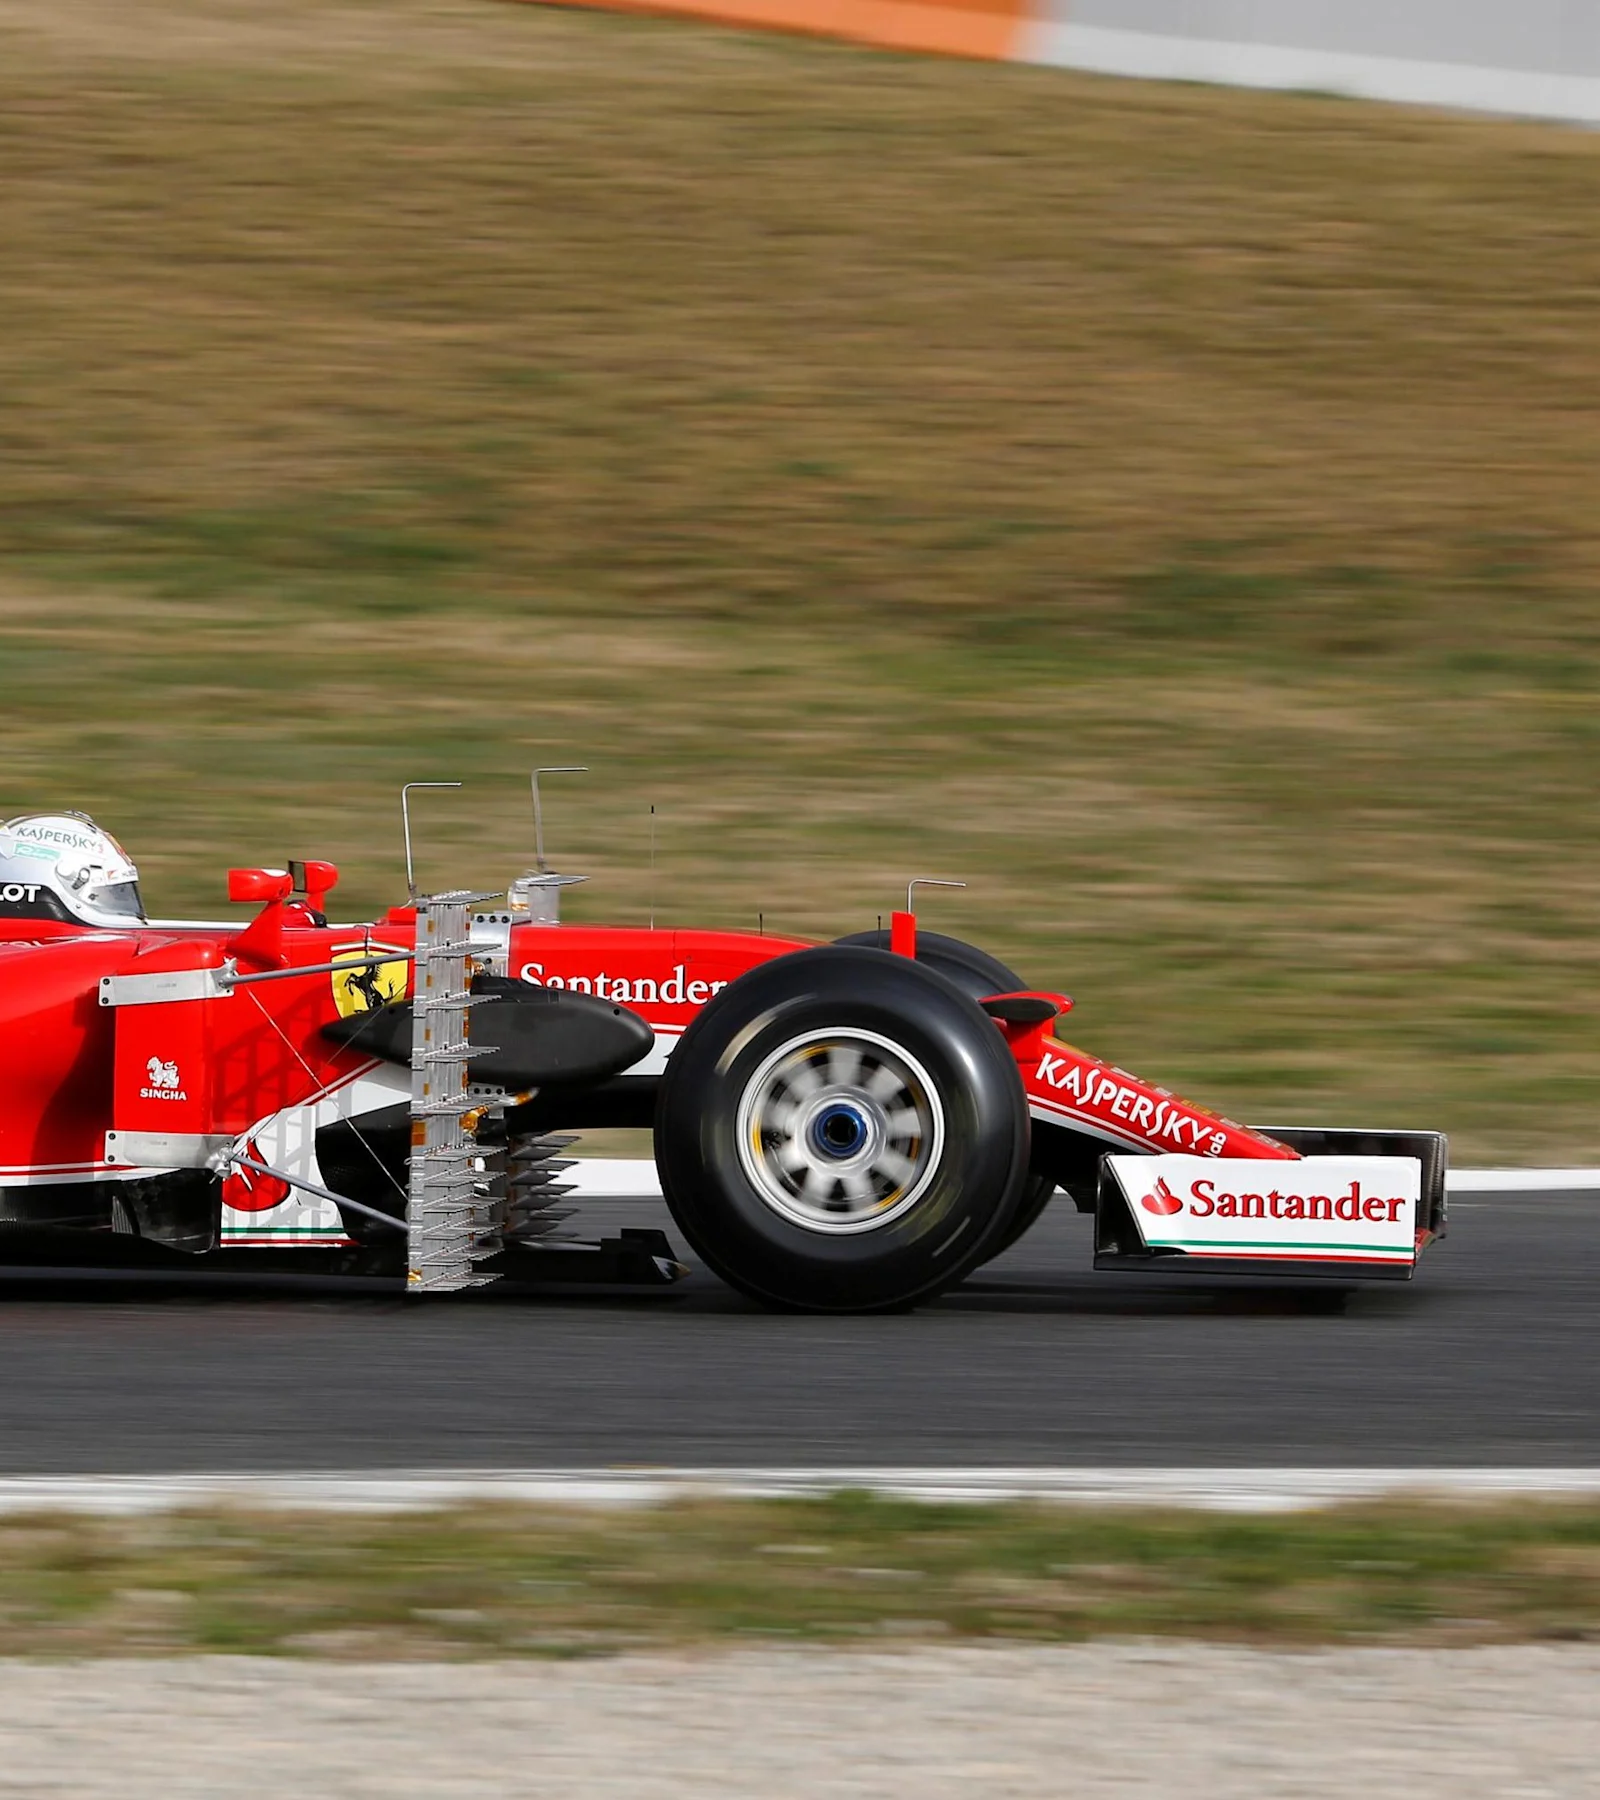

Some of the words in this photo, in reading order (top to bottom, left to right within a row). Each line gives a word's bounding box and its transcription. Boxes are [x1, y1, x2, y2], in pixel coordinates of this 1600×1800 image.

[16, 827, 97, 851] KASPERSKY
[140, 1087, 187, 1101] SINGHA
[1035, 1052, 1212, 1150] KASPERSKY
[1190, 1179, 1406, 1222] Santander
